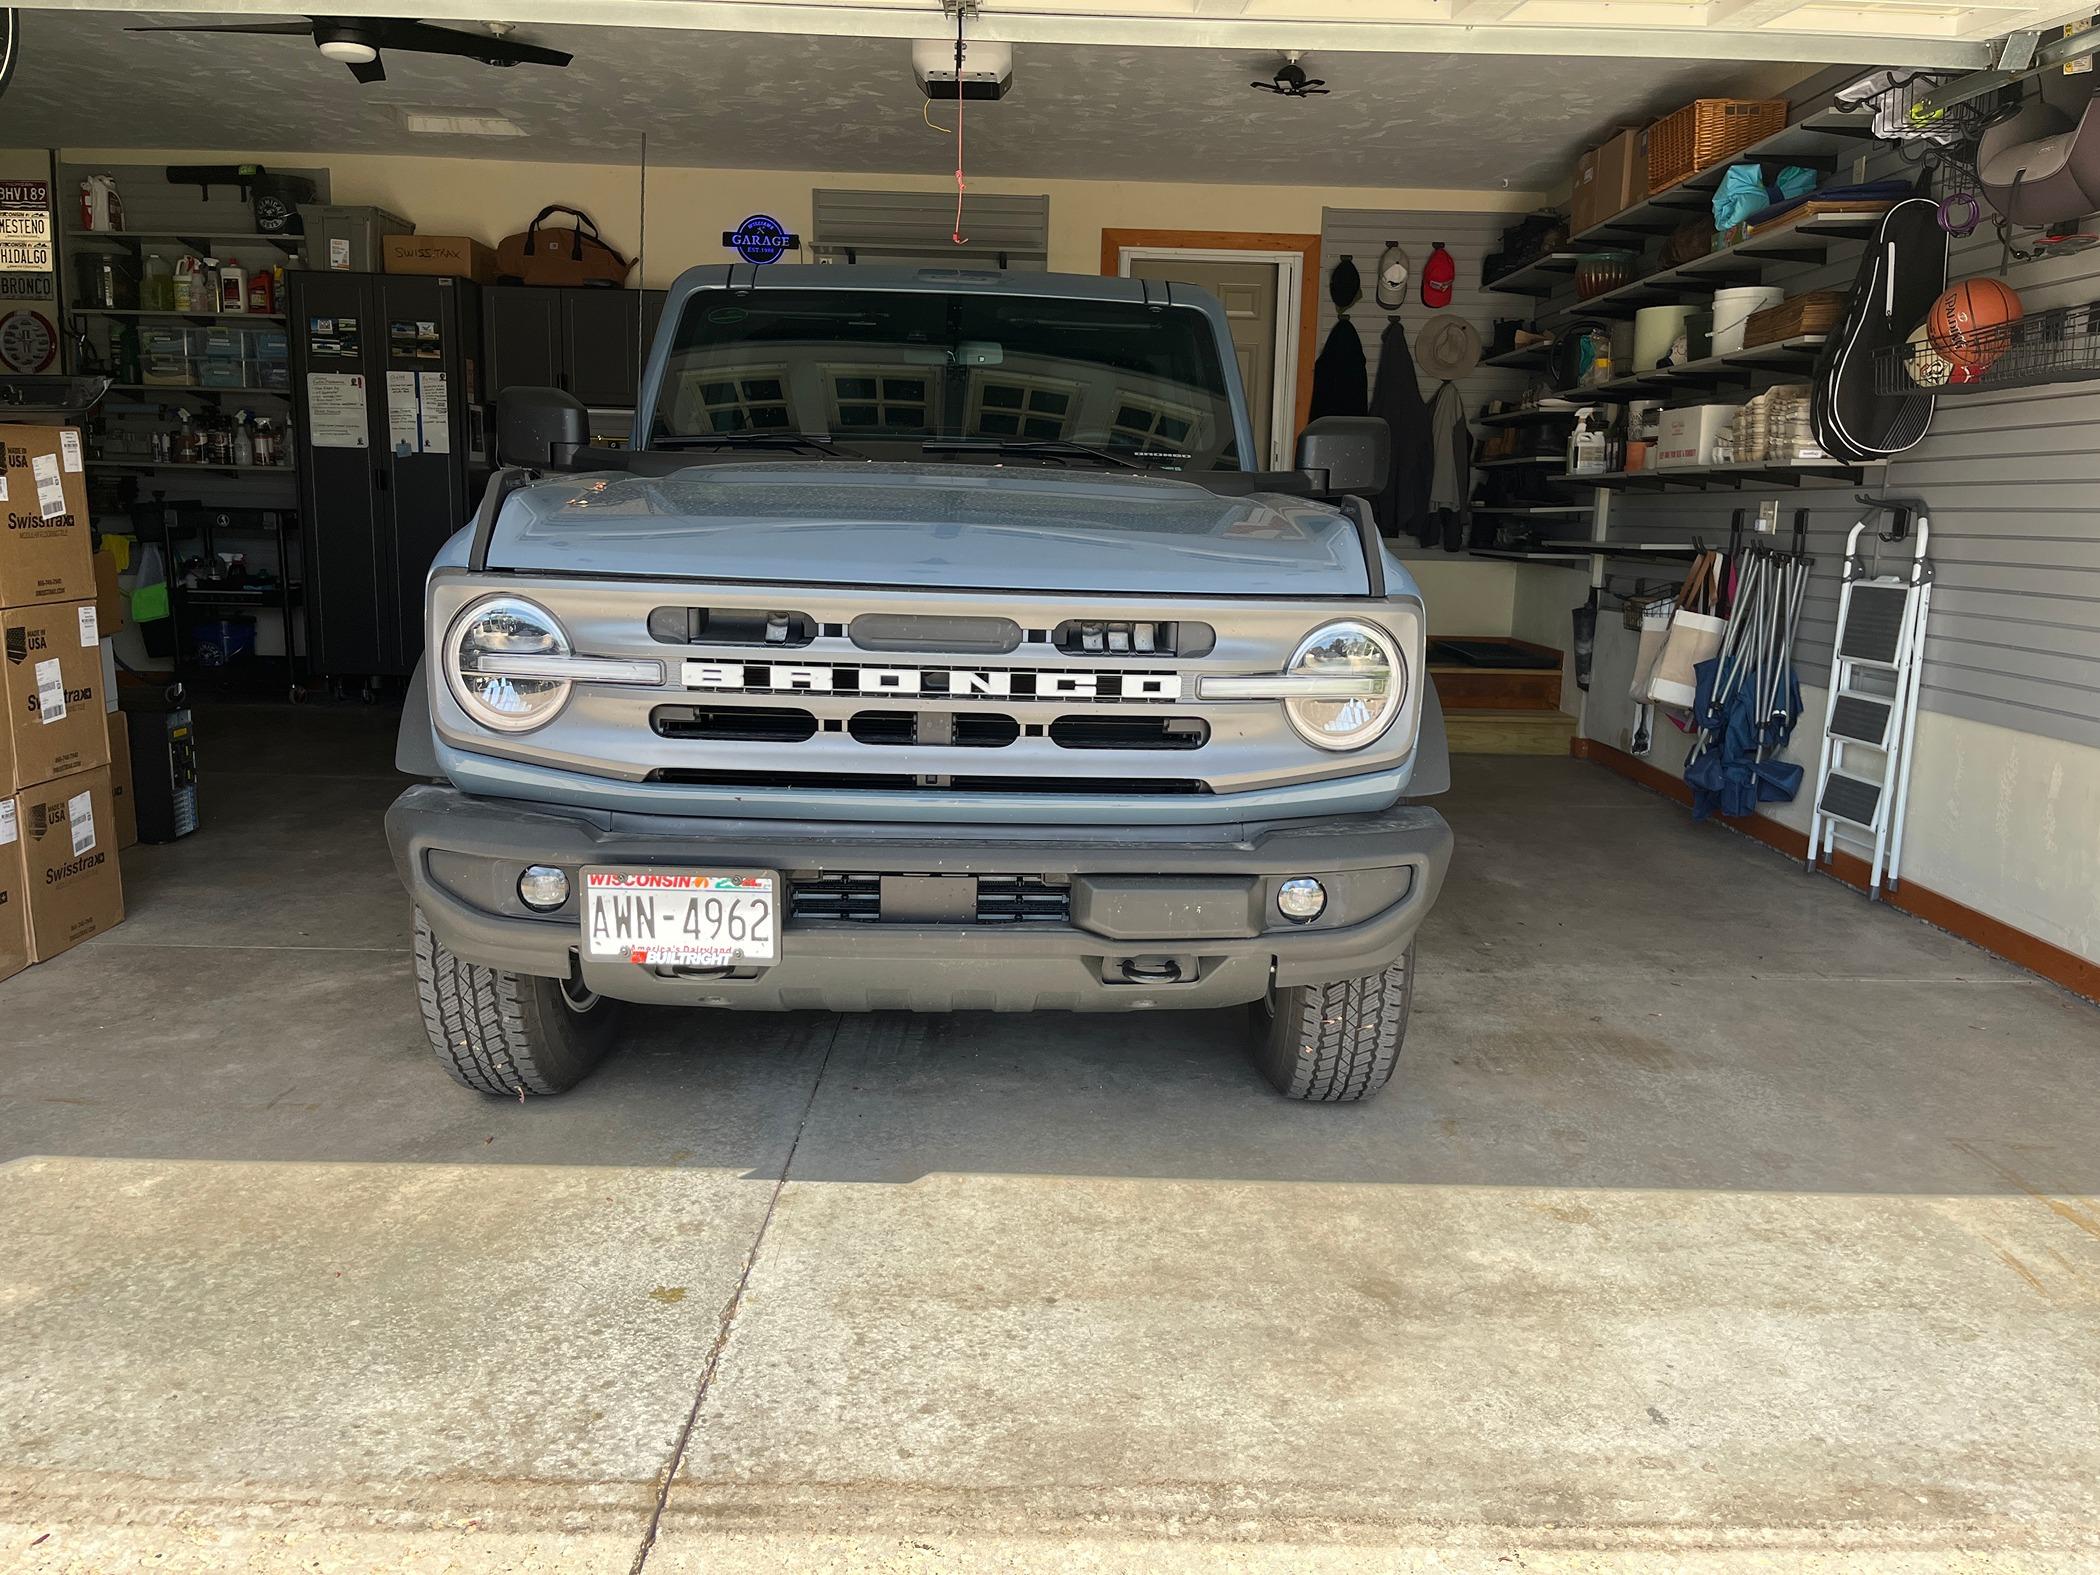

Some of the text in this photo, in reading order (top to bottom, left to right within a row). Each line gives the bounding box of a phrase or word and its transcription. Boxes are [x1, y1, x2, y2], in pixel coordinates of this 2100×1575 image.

[731, 234, 790, 247] GARAGE
[1, 277, 51, 295] BRONCO
[8, 455, 29, 468] USA
[28, 637, 47, 650] USA
[681, 662, 1182, 699] BRONCO
[48, 811, 66, 825] USA
[46, 855, 99, 885] Swisstrax
[590, 874, 691, 888] WISCONSIN
[593, 895, 769, 942] AWN-4962
[646, 952, 731, 965] BUILTRIGHT
